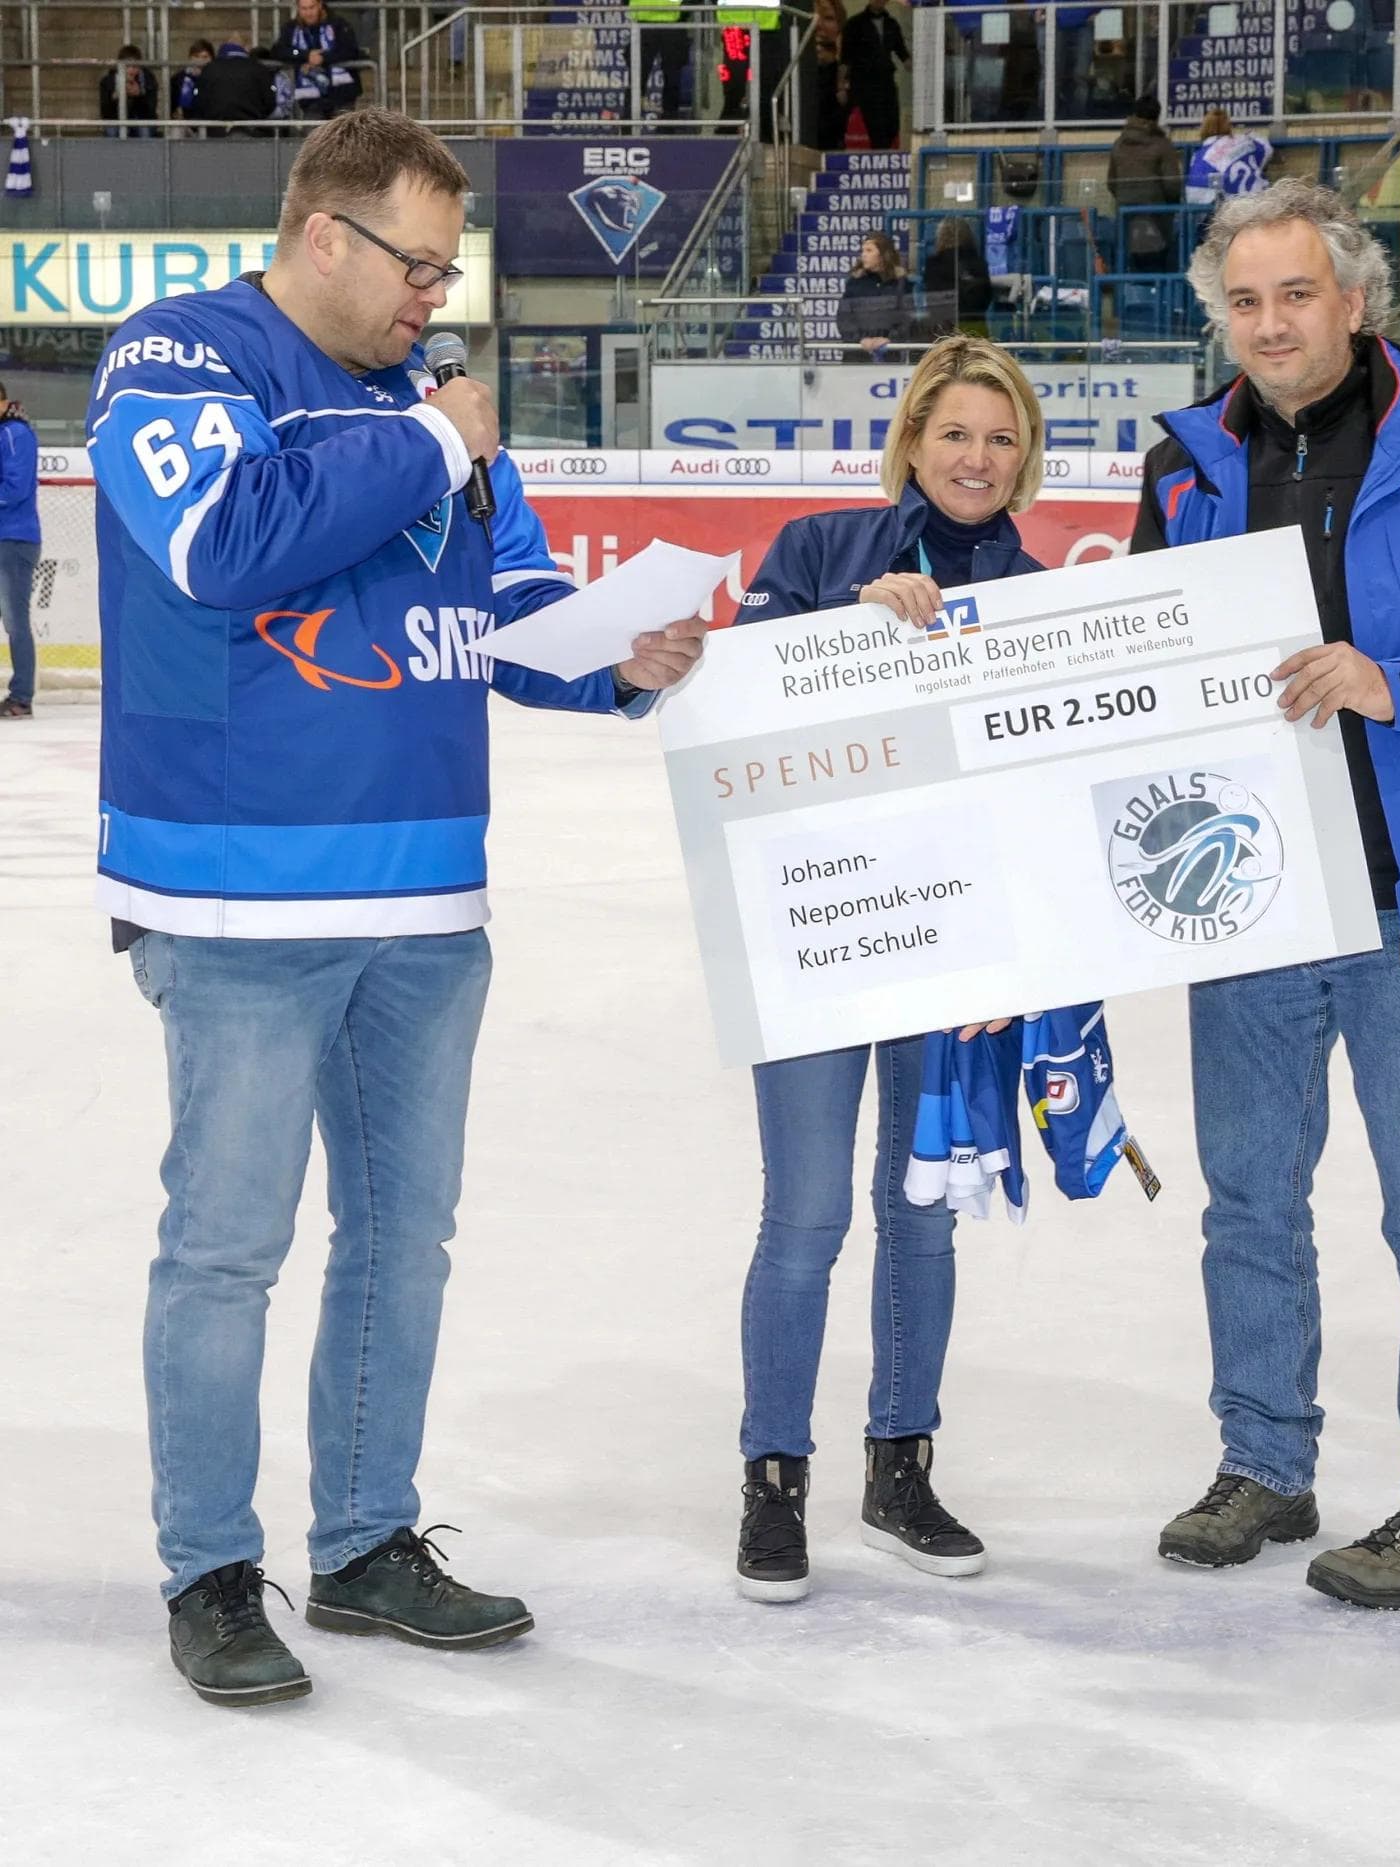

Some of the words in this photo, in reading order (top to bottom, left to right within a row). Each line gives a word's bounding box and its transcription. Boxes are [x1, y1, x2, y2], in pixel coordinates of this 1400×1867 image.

[572, 29, 631, 46] SAMS
[1202, 37, 1299, 56] SAMSUG
[1188, 59, 1288, 78] SAMSUN
[583, 148, 650, 167] ERC
[828, 194, 908, 211] SAMSUN
[132, 402, 243, 498] 64
[515, 459, 555, 474] udi
[670, 459, 719, 474] Audi
[831, 459, 879, 475] Audi
[774, 621, 902, 665] Volksbank
[782, 641, 974, 698] Raiffeisenbank
[985, 628, 1073, 661] Bayern
[1082, 614, 1147, 643] Mitte
[1157, 603, 1190, 629] eG
[914, 674, 972, 695] Ingolstadt
[982, 659, 1056, 681] Pfaffenhofen
[1125, 635, 1194, 656] Weißenburg
[984, 703, 1055, 741] EUR
[1062, 684, 1157, 727] 2.500
[1200, 672, 1273, 708] Euro
[713, 736, 901, 799] SPENDE
[1112, 771, 1207, 842] GOALS
[780, 853, 878, 887] Johann-
[789, 878, 973, 928] Nepomuk-von-
[1116, 875, 1163, 927] FOR
[1170, 909, 1239, 942] KIDS
[796, 943, 853, 970] Kurz
[857, 924, 939, 958] Schule
